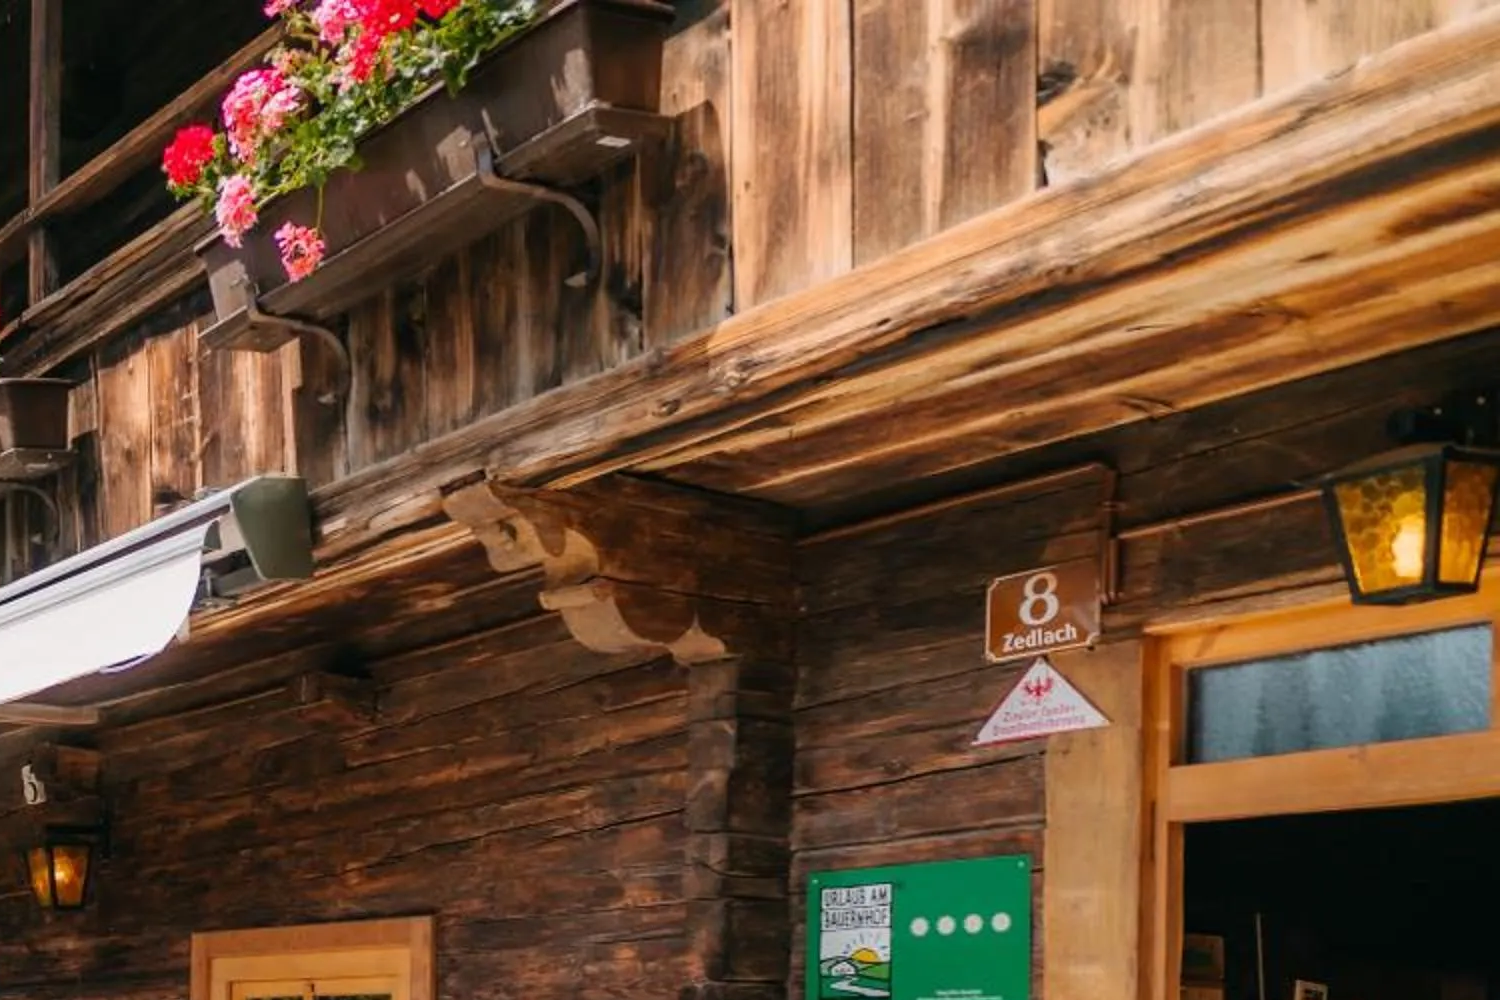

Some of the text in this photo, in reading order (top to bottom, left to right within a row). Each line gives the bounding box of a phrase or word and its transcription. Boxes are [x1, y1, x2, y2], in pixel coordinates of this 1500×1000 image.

[1018, 572, 1059, 626] 8
[1002, 623, 1077, 652] Zedlach
[824, 885, 888, 907] URLAUB AM
[824, 907, 888, 929] BAUERNHOF
